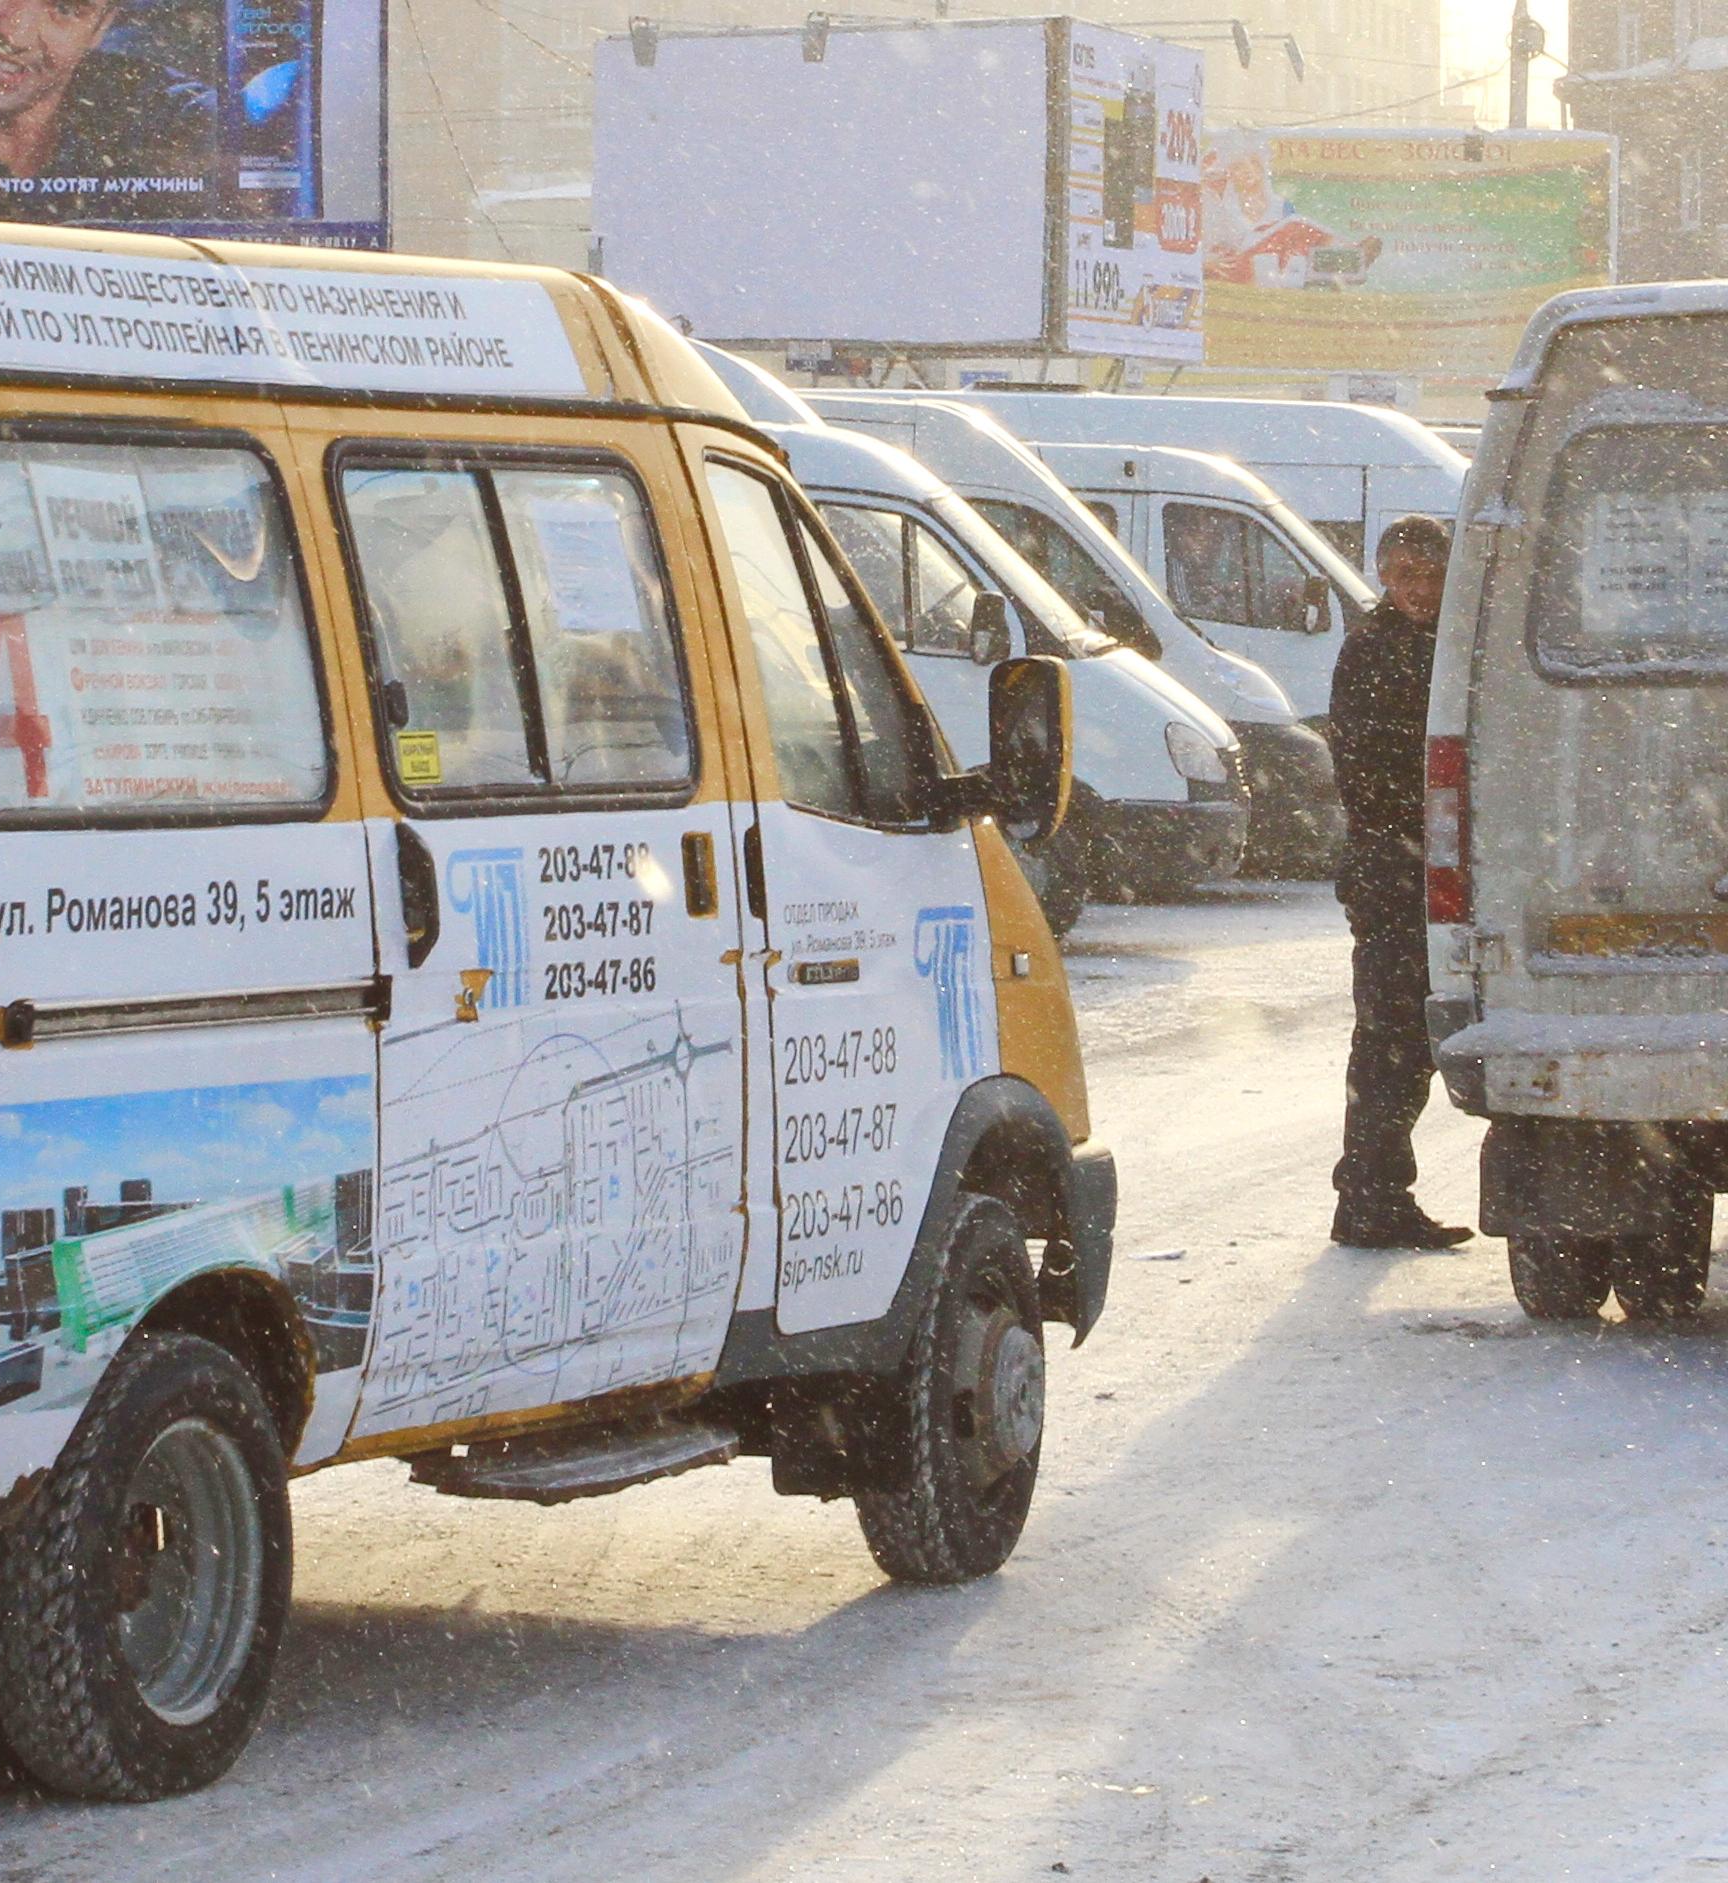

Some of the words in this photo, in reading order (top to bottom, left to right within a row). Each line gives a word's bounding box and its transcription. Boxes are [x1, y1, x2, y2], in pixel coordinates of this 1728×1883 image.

[40, 178, 98, 193] ХОТЯТ
[104, 177, 203, 193] МУЖЧИНЫ
[85, 266, 301, 314] ОБЩЕСТВЕННОГО
[299, 284, 452, 320] НАЗНАЧЕНИЯ
[449, 295, 468, 321] И
[22, 308, 62, 342] ПО
[62, 309, 271, 356] УЛ.ТРОЛЛЕЙНАЯ
[288, 329, 425, 367] ЛЕНИНСКОМ
[427, 332, 515, 368] РАЙОНЕ
[45, 886, 197, 934] Романова
[205, 879, 247, 933] 39,
[254, 878, 272, 924] 5
[278, 884, 357, 920] этаж
[543, 900, 655, 942] 203-47-87
[544, 956, 657, 1000] 203-47-86
[784, 1026, 897, 1085] 203-47-88
[784, 1103, 897, 1164] 203-47-87
[785, 1179, 903, 1242] 203-47-86
[782, 1245, 864, 1293] sip-nsk.ru
